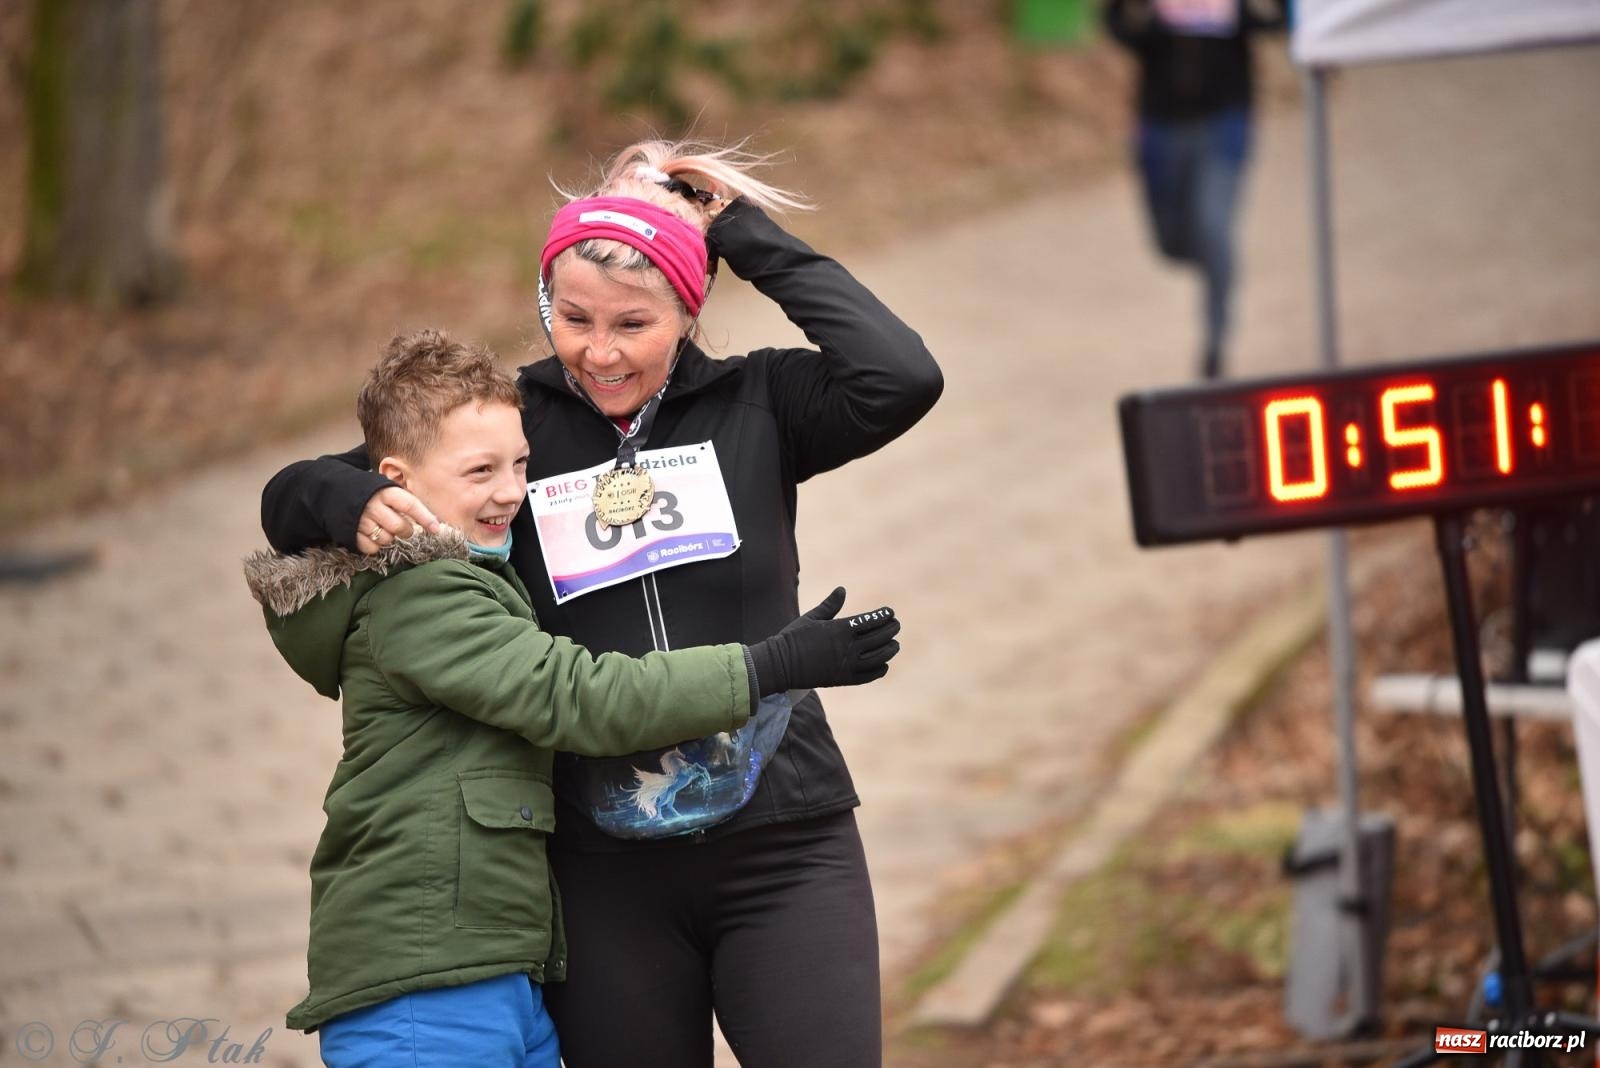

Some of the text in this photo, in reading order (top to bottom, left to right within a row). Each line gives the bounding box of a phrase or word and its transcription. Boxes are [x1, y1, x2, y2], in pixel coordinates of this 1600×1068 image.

[545, 479, 588, 498] BIEG
[660, 542, 704, 558] Racibórz
[848, 609, 891, 628] KIPSTA
